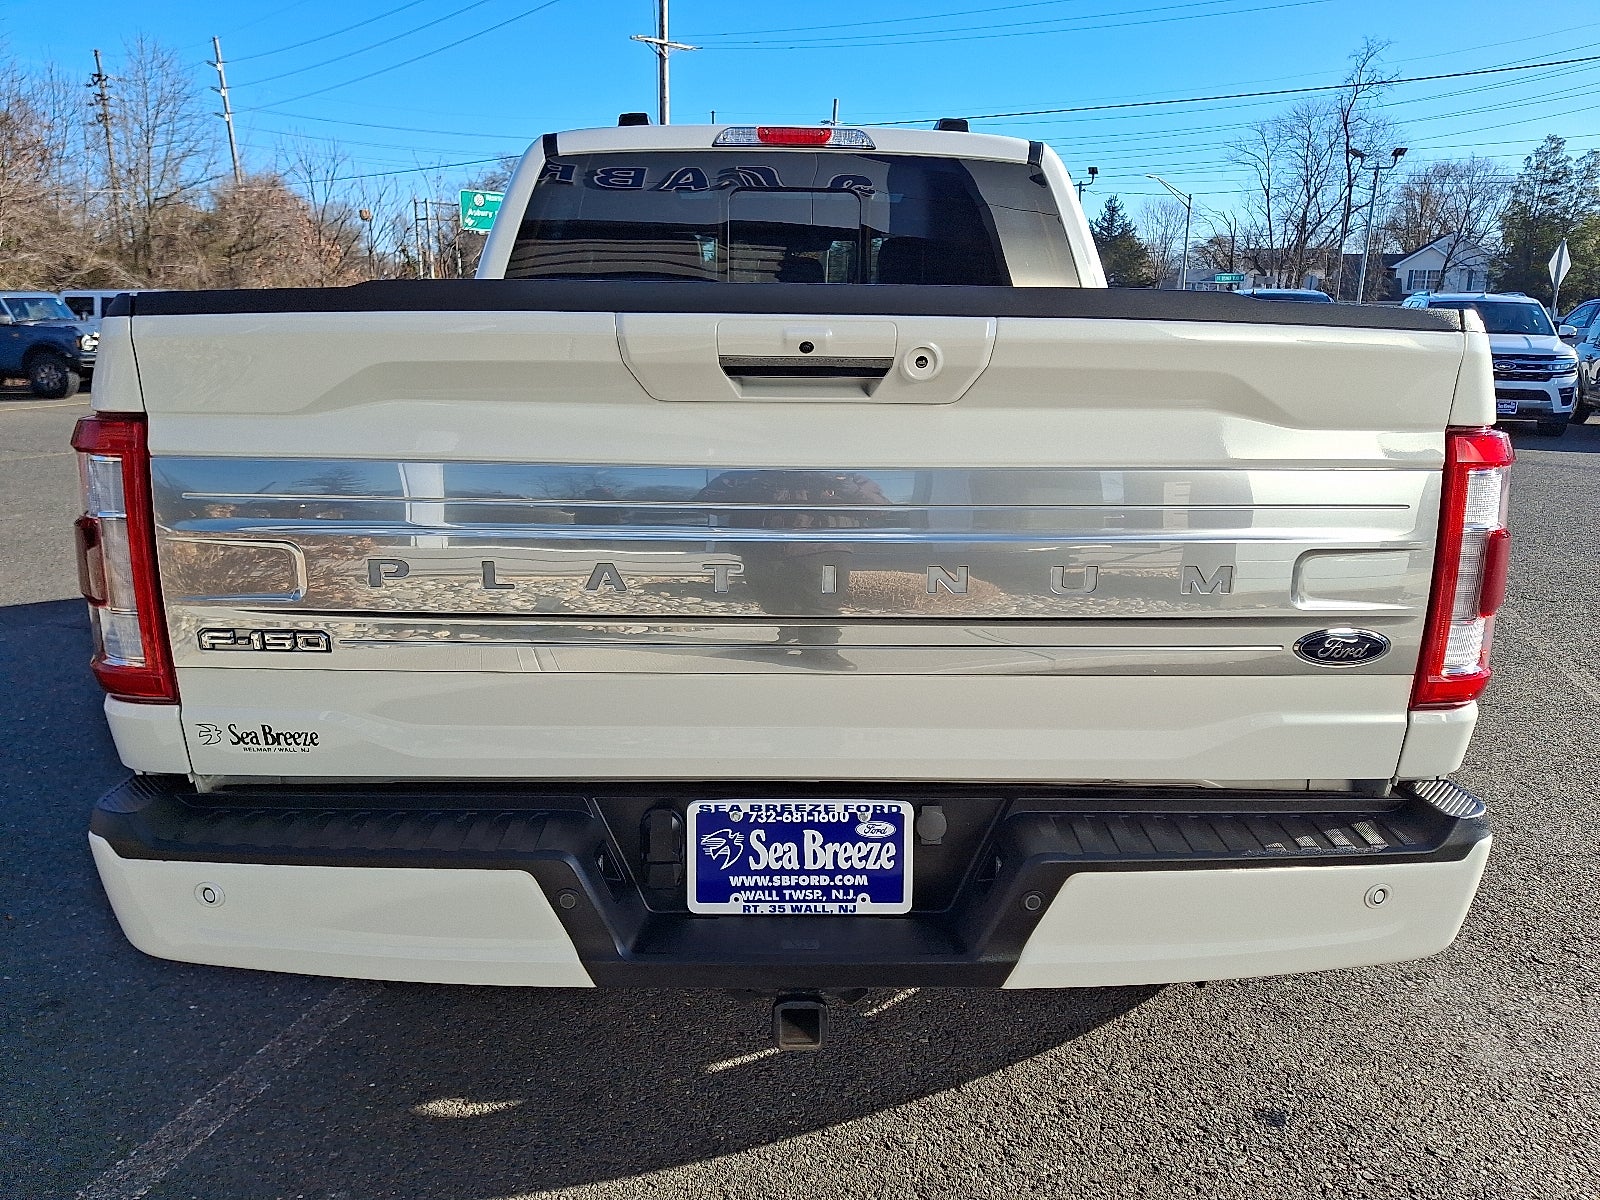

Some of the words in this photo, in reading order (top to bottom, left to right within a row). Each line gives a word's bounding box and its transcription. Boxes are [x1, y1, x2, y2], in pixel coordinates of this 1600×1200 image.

[367, 558, 1235, 594] PLATINUM
[197, 628, 332, 653] F-150
[1316, 637, 1371, 658] Ford
[227, 723, 261, 746] Sea
[261, 724, 320, 747] Breeze
[698, 804, 744, 814] SEA
[750, 804, 836, 814] BREEZE
[843, 804, 902, 815] FORD
[748, 812, 850, 823] 732-681-1600
[863, 824, 888, 835] Ford
[749, 829, 800, 870] Sea
[803, 829, 897, 870] Breeze
[729, 875, 869, 887] WWW.SBFORD.COM
[741, 890, 780, 901] WALL
[832, 889, 857, 900] N.J.
[742, 904, 765, 913] RT.
[768, 904, 787, 913] 35
[838, 904, 857, 914] NJ
